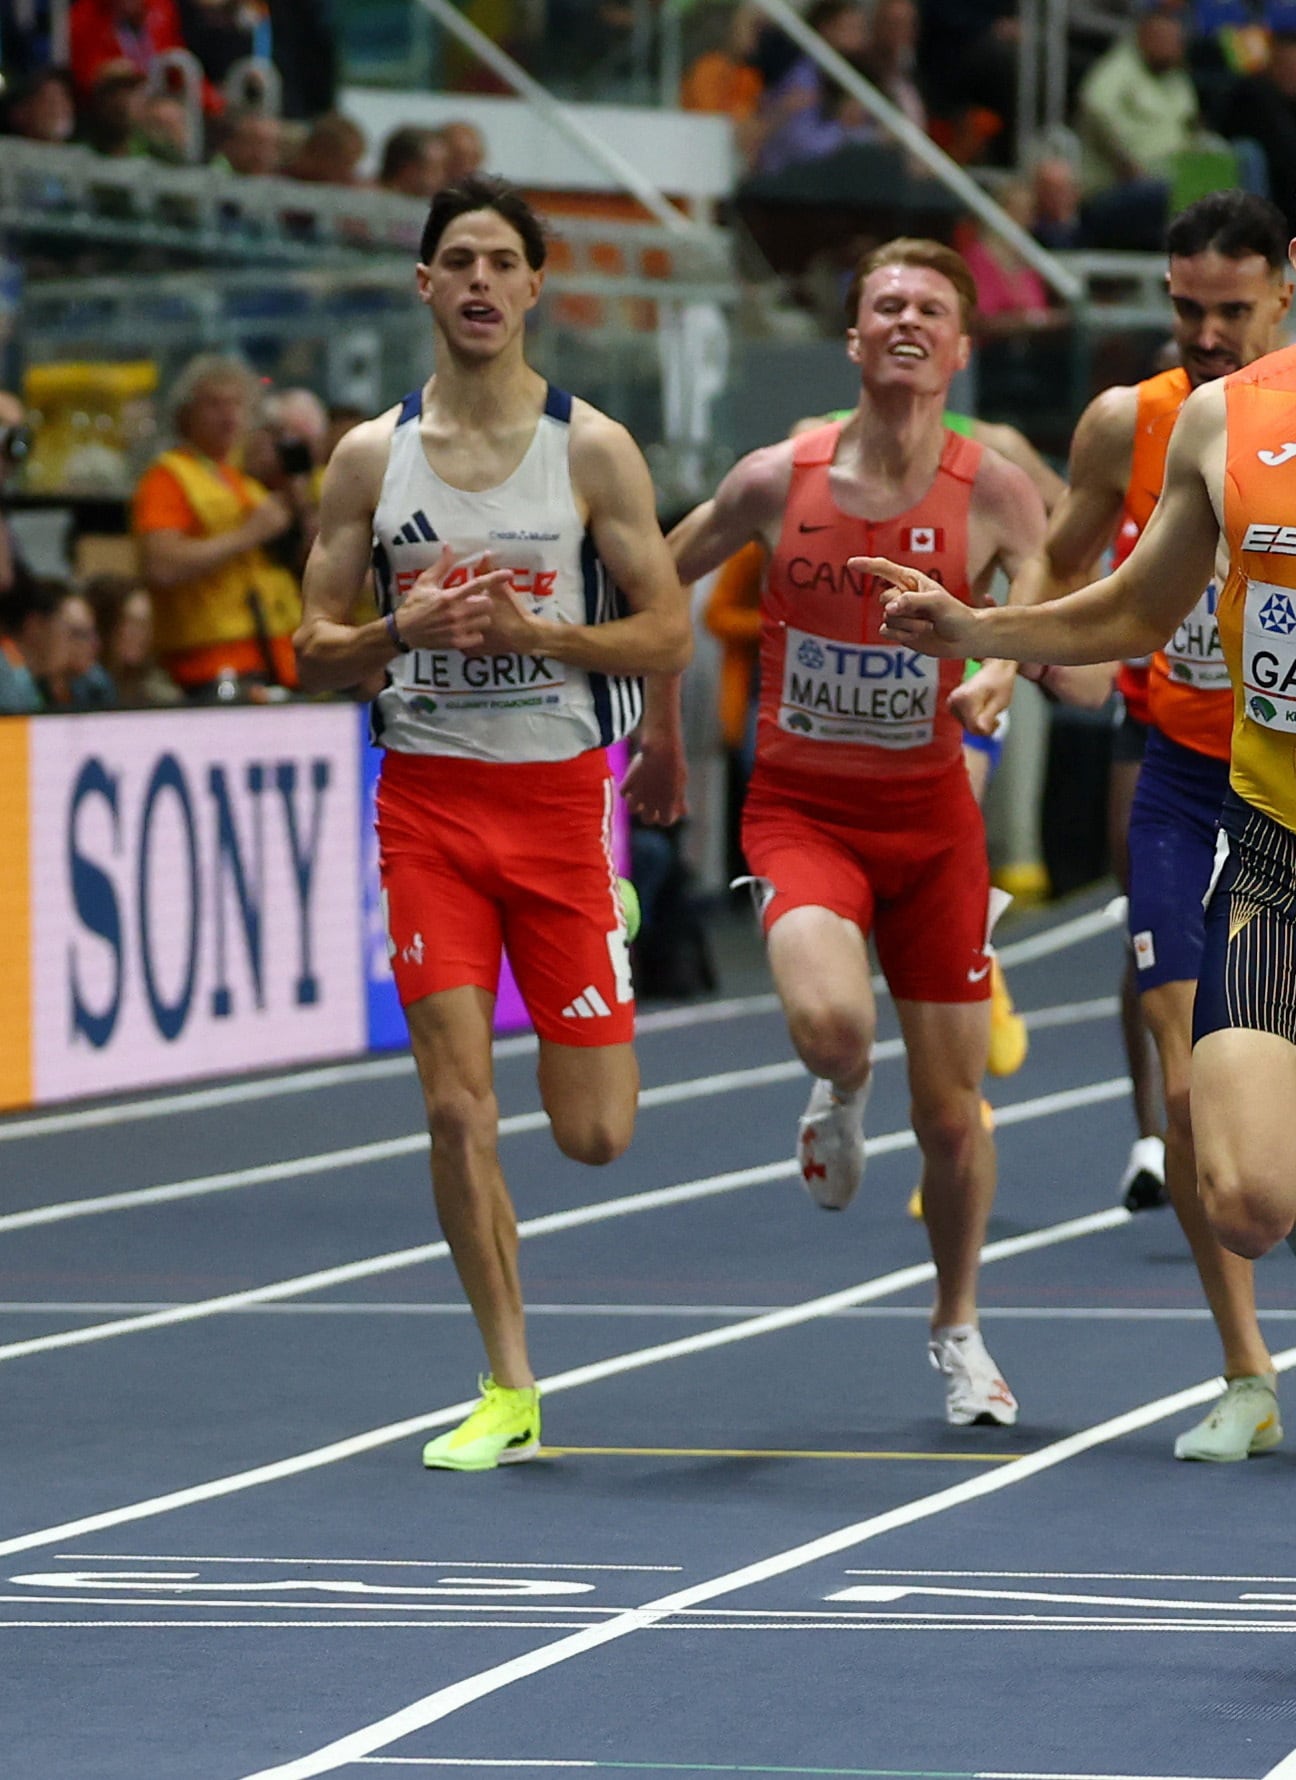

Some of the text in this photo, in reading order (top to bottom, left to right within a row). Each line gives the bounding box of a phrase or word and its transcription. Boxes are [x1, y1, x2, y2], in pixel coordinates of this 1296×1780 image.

[395, 566, 557, 597] FACE
[788, 556, 943, 595] CAN
[414, 651, 554, 688] LE GRIX
[825, 643, 926, 680] TDK
[790, 672, 929, 720] MALLECK
[66, 751, 333, 1052] SONY
